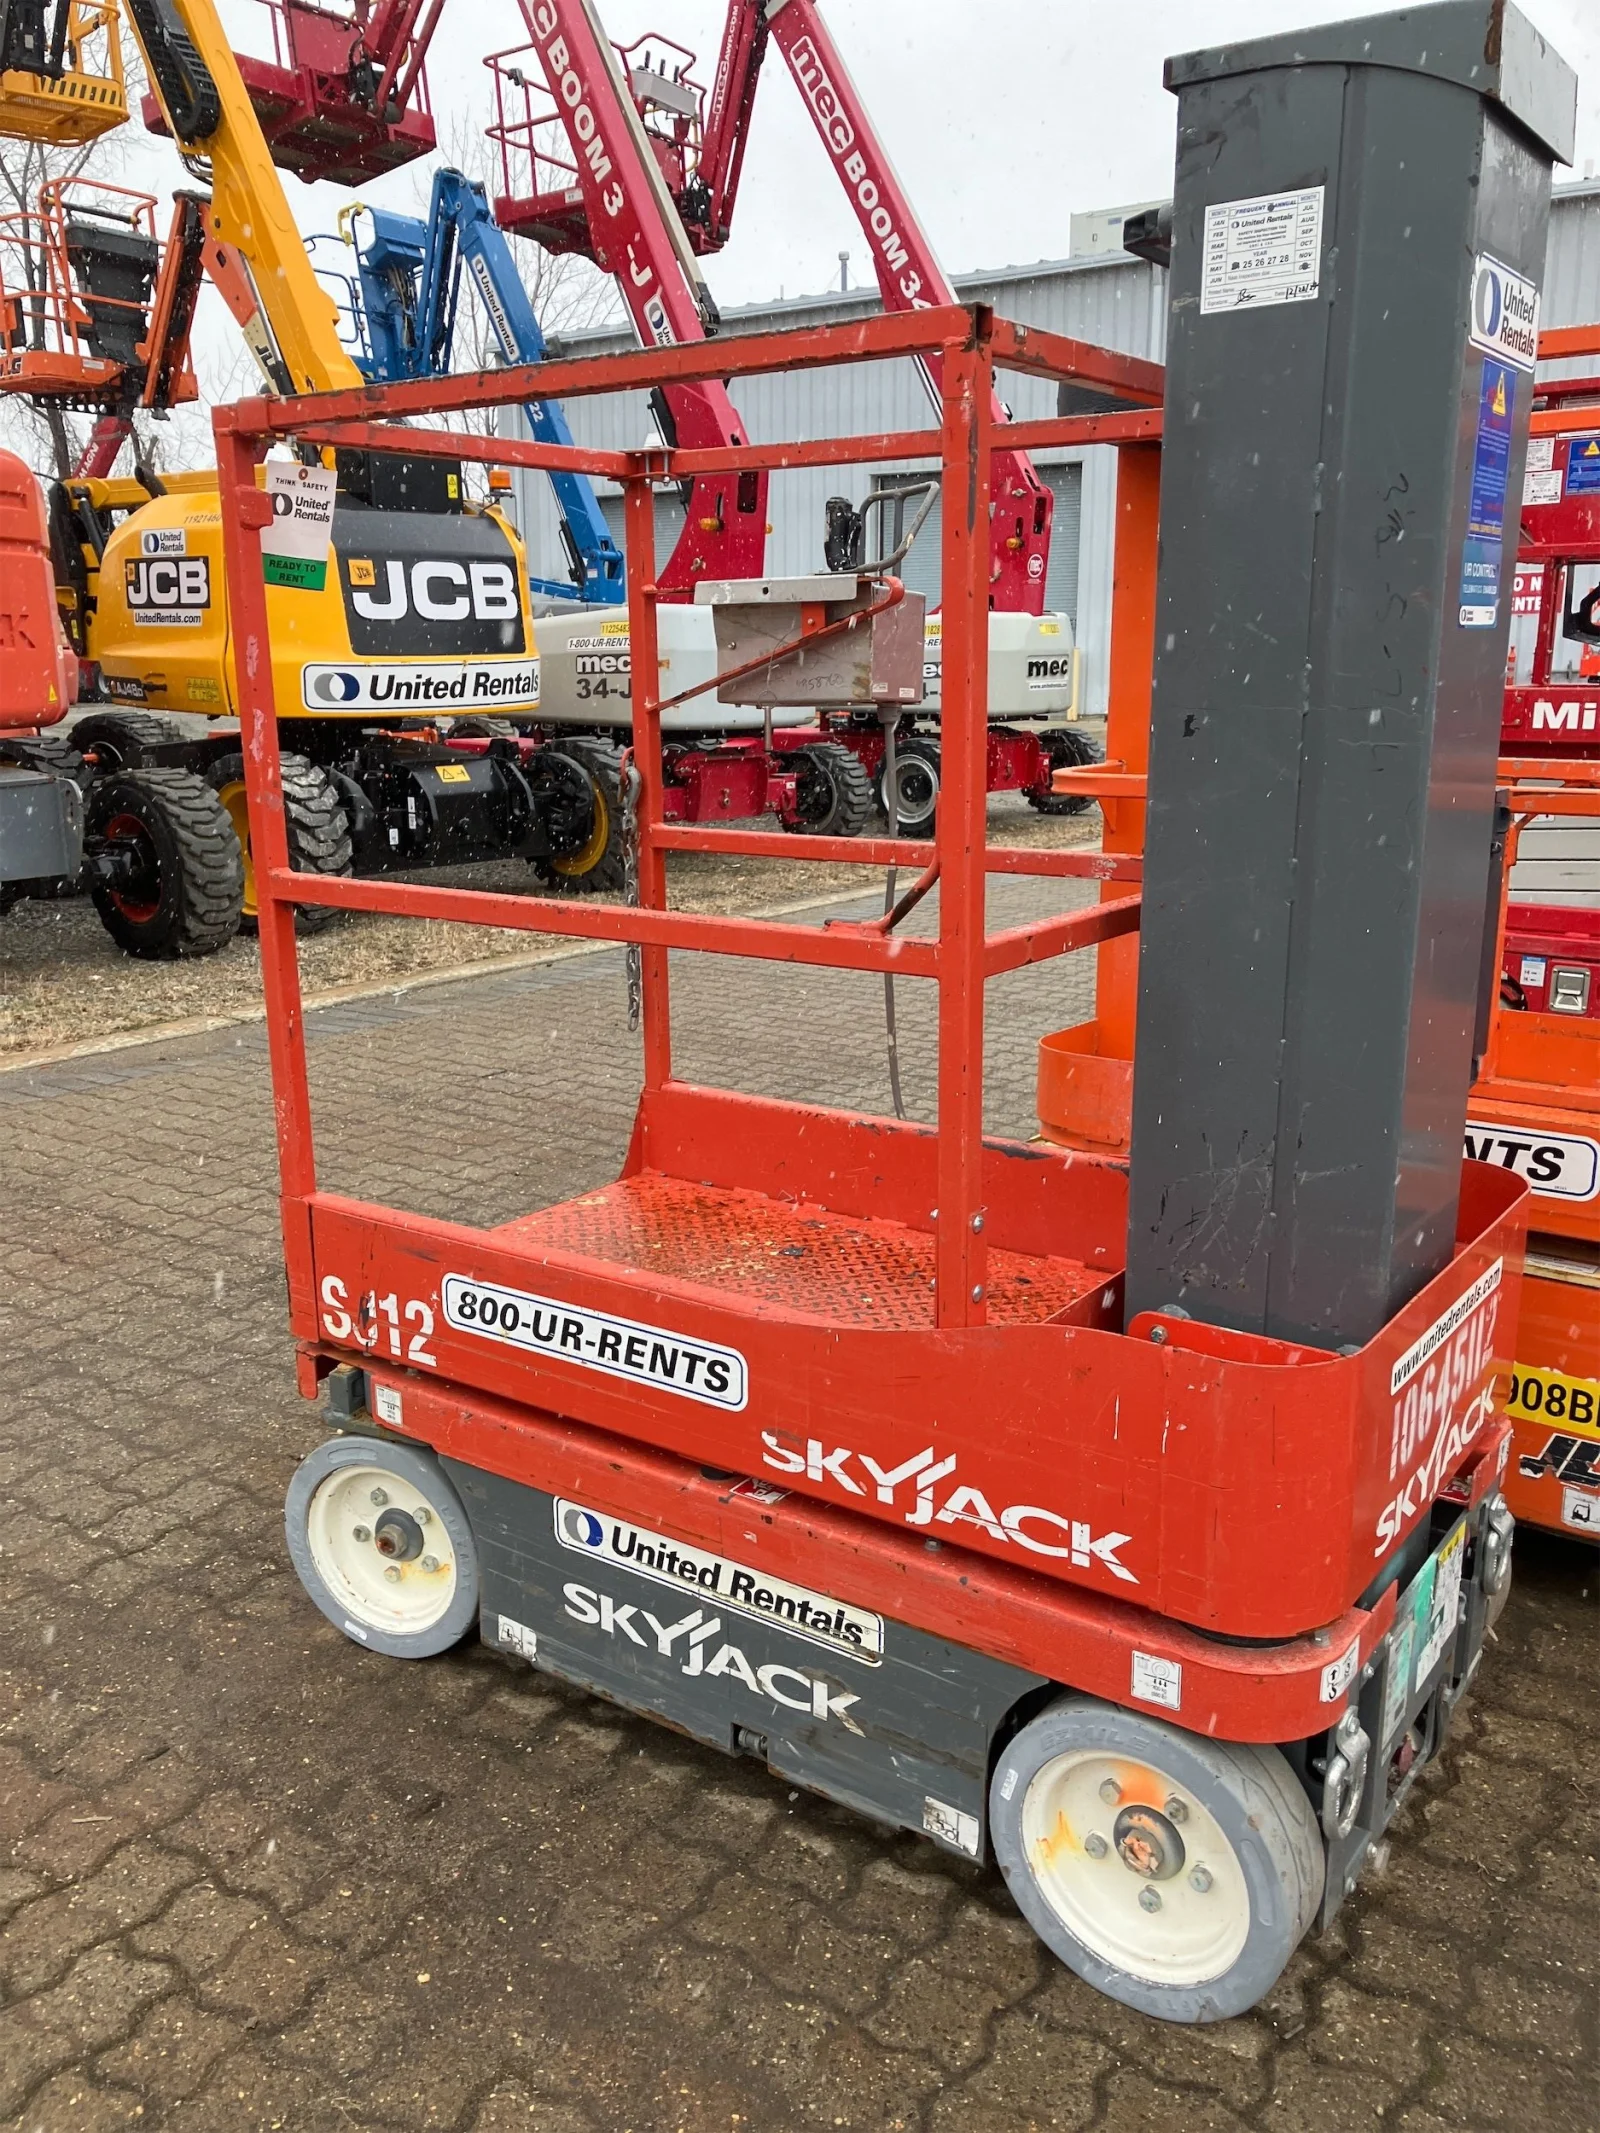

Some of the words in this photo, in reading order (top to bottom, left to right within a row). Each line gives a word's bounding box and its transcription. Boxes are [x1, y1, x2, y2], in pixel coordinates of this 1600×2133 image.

[547, 35, 611, 183] BOOM
[603, 182, 624, 217] 3
[793, 39, 851, 150] mec
[843, 150, 909, 271] BOOM
[1212, 219, 1226, 227] JAN
[1241, 219, 1265, 228] United
[1266, 212, 1294, 224] Rentals
[1302, 204, 1314, 212] JUL
[1235, 204, 1266, 216] FREQUENT
[1300, 215, 1315, 223] AUG
[1212, 230, 1224, 238] FEB
[1301, 227, 1314, 236] SEP
[1210, 242, 1225, 250] MAR
[1300, 239, 1313, 247] OCT
[1209, 264, 1223, 273] MAY
[1242, 260, 1253, 269] 25
[1255, 258, 1265, 267] 26
[1267, 256, 1277, 265] 27
[1280, 254, 1290, 263] 28
[1210, 253, 1224, 261] APR
[1253, 249, 1268, 257] YEAR
[1299, 251, 1313, 259] NOV
[1209, 276, 1223, 284] JUN
[1503, 282, 1536, 325] United
[481, 275, 500, 313] United
[496, 313, 516, 356] Rentals
[1500, 314, 1535, 358] Rentals
[275, 476, 296, 487] THINK
[302, 482, 329, 492] SAFETY
[295, 496, 330, 511] United
[294, 508, 330, 523] Rentals
[159, 532, 182, 542] United
[160, 542, 184, 553] Rentals
[269, 559, 302, 571] READY
[305, 563, 317, 572] TO
[127, 561, 208, 605] JCB
[278, 573, 306, 584] RENT
[352, 560, 519, 620] JCB
[134, 612, 201, 624] UnitedRentals.com
[576, 655, 631, 674] mec
[1028, 659, 1068, 678] mec
[369, 672, 467, 701] United
[473, 667, 539, 697] Rentals
[321, 1274, 438, 1367] SJ12
[1393, 1266, 1501, 1388] www.unitedrentals.com
[457, 1291, 731, 1394] 800-UR-RENTS
[1374, 1373, 1498, 1557] SKYJACK
[761, 1429, 1141, 1585] SKYJACK
[612, 1525, 721, 1590] United
[729, 1569, 864, 1646] Rentals
[562, 1582, 867, 1738] SKYJACK
